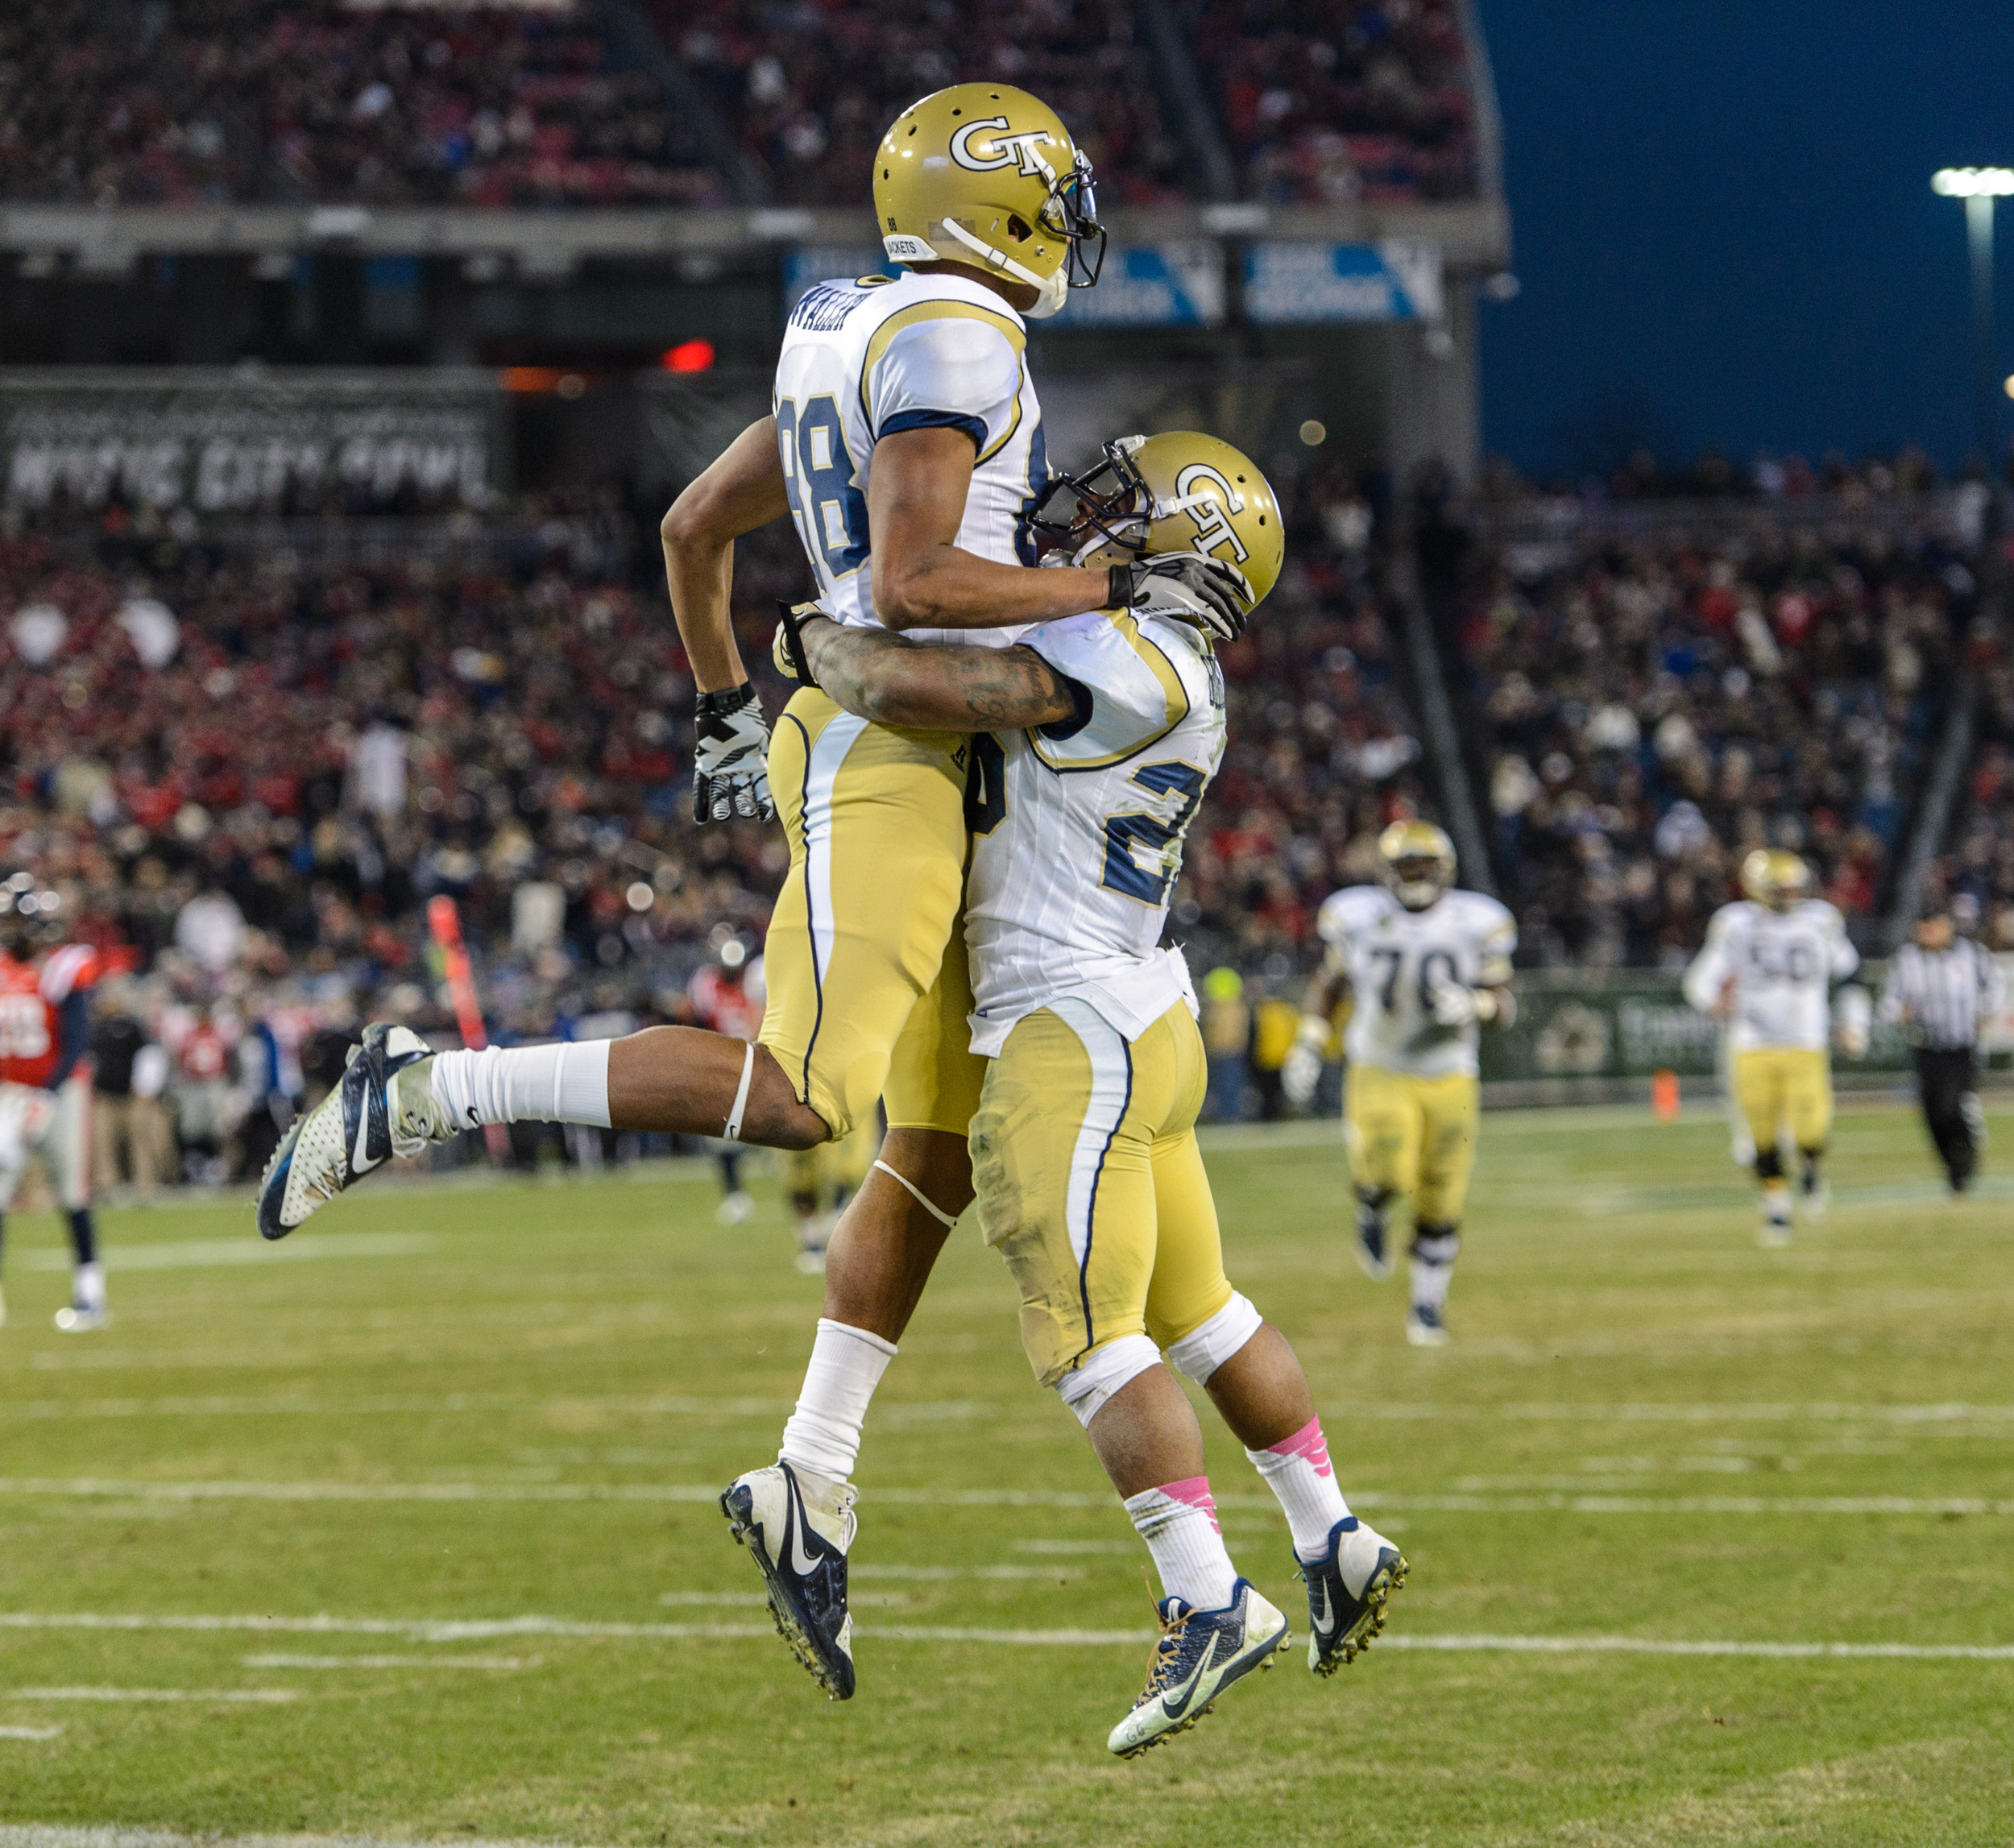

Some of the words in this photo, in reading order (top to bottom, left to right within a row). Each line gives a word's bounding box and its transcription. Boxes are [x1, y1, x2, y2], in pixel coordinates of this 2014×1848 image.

[949, 115, 1050, 177] GT
[887, 217, 897, 232] 88
[777, 392, 871, 598] 88
[1175, 462, 1250, 566] GT
